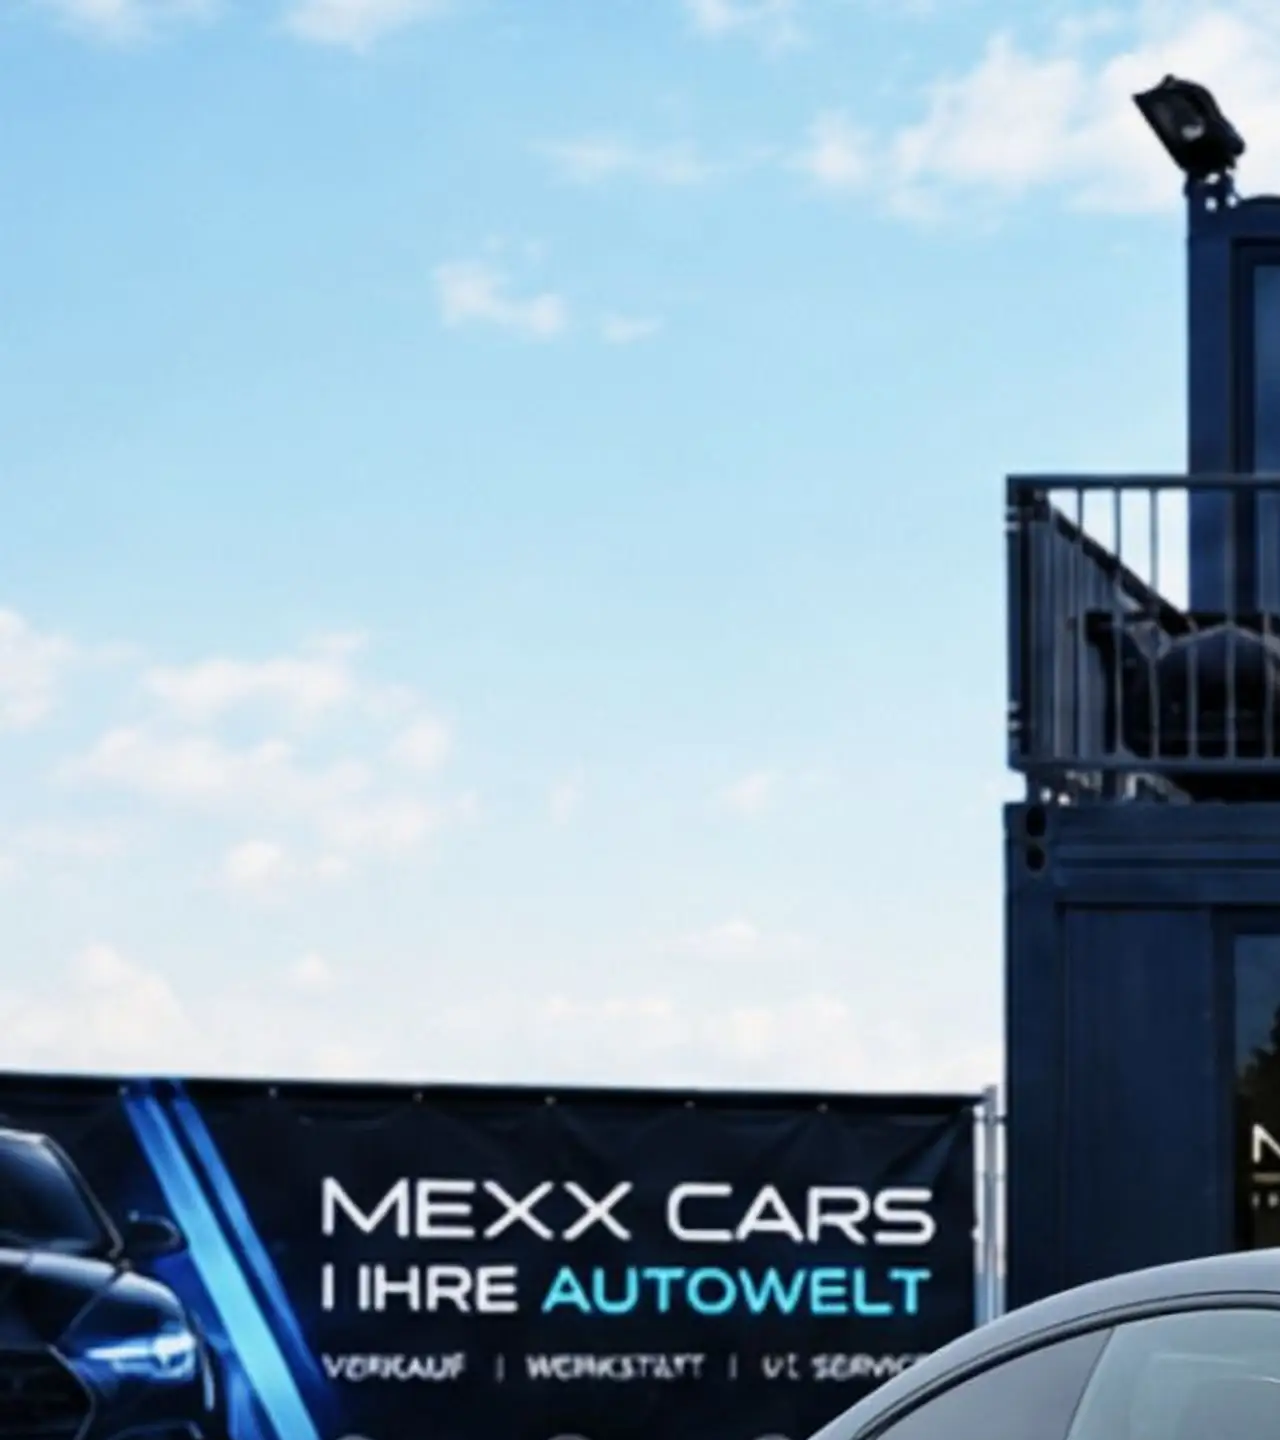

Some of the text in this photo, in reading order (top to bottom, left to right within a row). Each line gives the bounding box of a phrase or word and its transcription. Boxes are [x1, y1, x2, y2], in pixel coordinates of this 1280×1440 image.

[322, 1176, 936, 1245] MEXX CARS
[358, 1264, 518, 1313] IHRE
[541, 1266, 931, 1315] AUTOWELT
